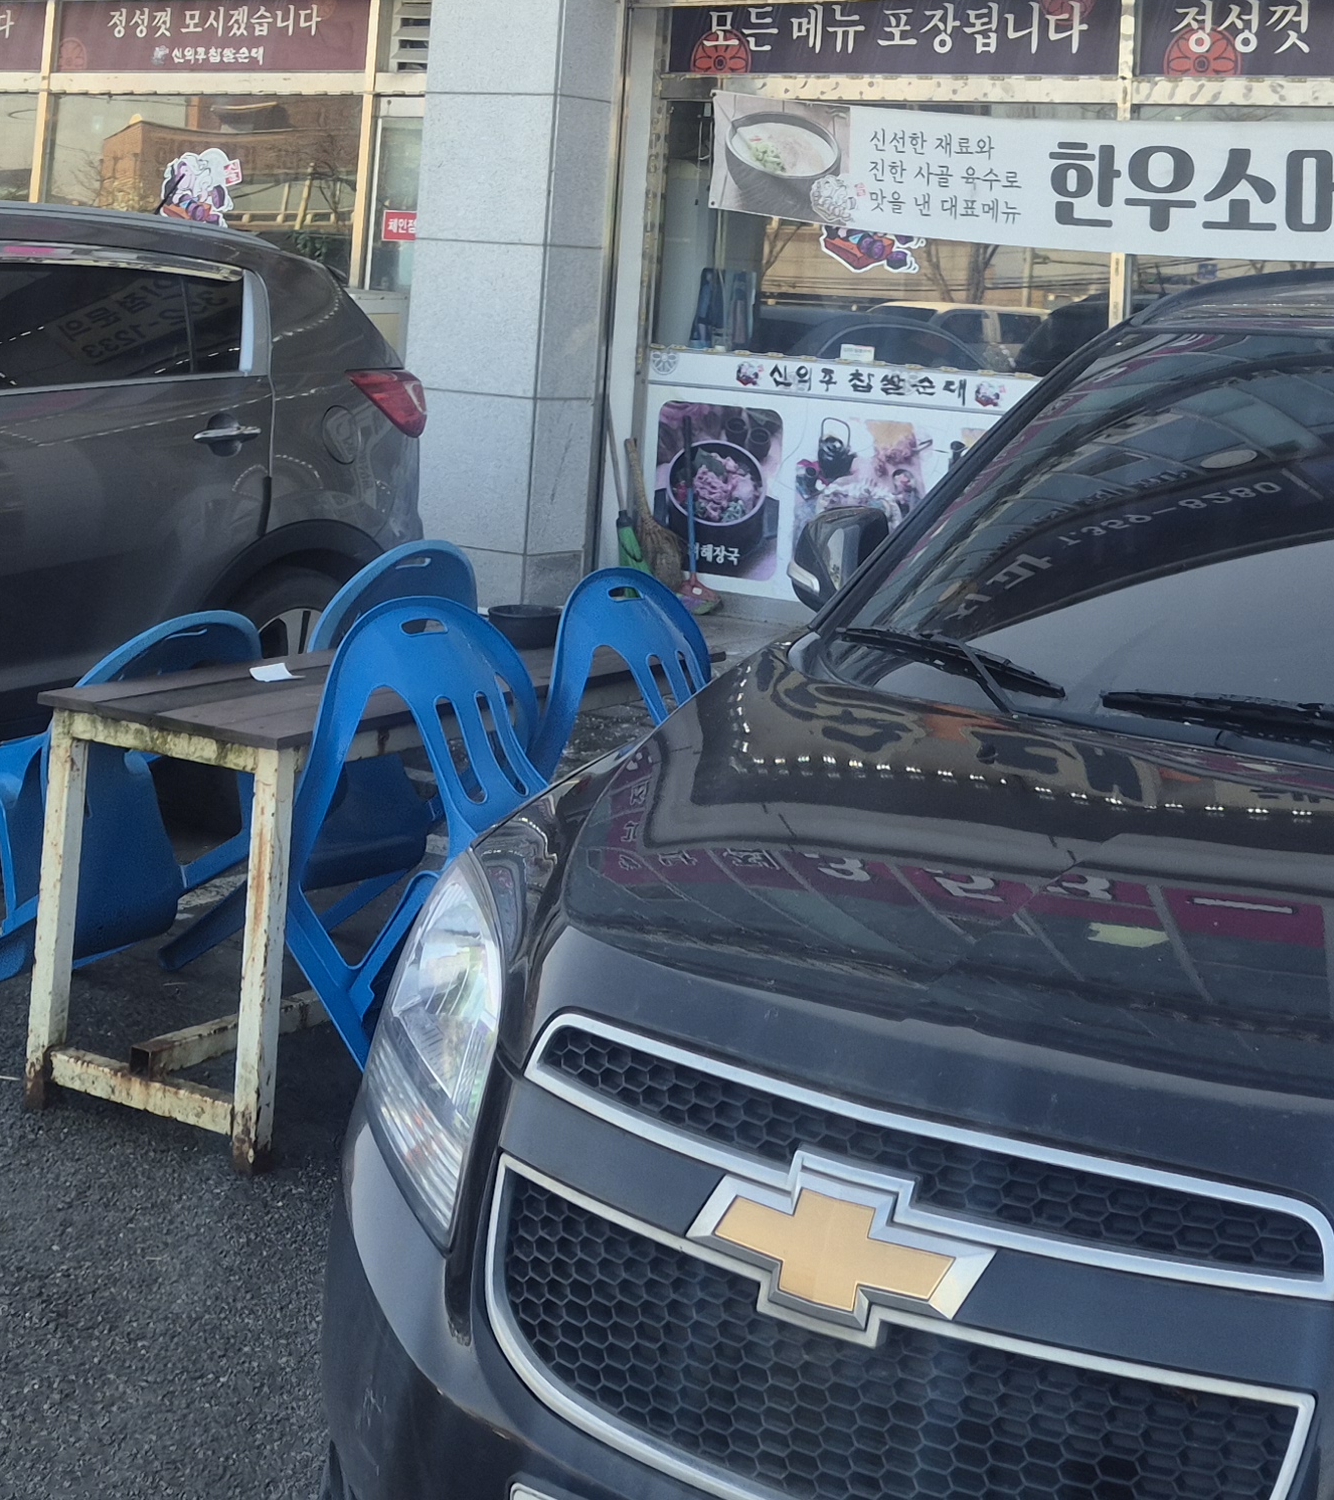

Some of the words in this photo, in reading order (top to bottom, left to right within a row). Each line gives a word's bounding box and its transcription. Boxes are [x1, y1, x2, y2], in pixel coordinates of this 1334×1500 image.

[107, 6, 173, 38] 정성껏
[180, 3, 322, 37] 모시겠습니다
[701, 6, 778, 52] 모든
[790, 3, 866, 55] 메뉴
[876, 0, 1088, 55] 포장됩니다
[869, 131, 928, 157] 신선한
[934, 132, 995, 161] 재료와
[869, 160, 906, 186] 진한
[912, 162, 954, 189] 사골
[959, 165, 1023, 192] 육수로
[869, 189, 906, 217] 맛을
[912, 193, 933, 220] 낸
[940, 196, 1023, 225] 대표메뉴
[387, 217, 417, 234] 체인점
